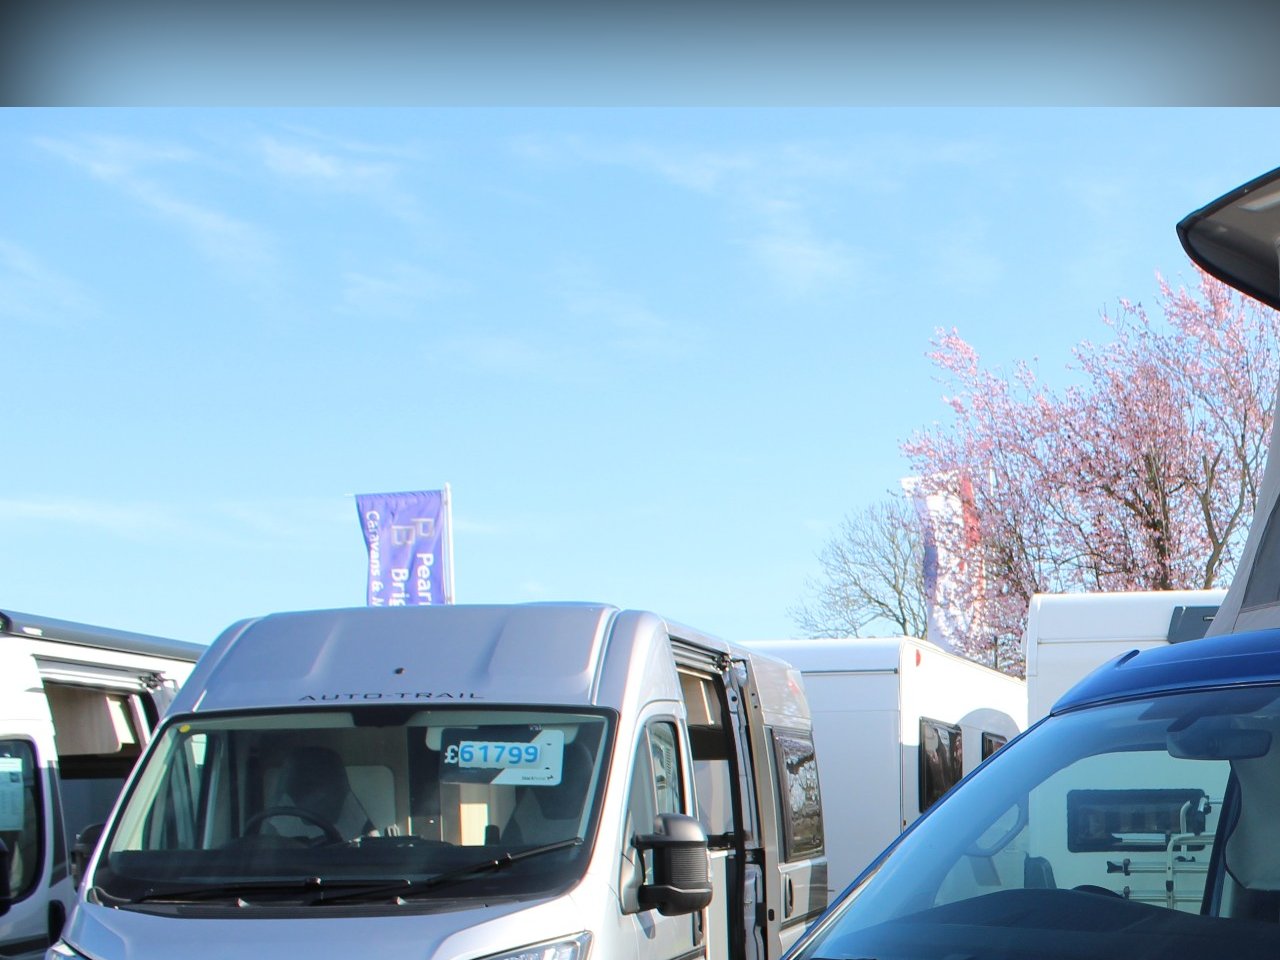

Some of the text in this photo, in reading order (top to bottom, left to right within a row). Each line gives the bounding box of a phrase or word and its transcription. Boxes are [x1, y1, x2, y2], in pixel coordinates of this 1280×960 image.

[366, 510, 382, 576] Caravans
[371, 581, 384, 593] &
[444, 744, 538, 764] £61799
